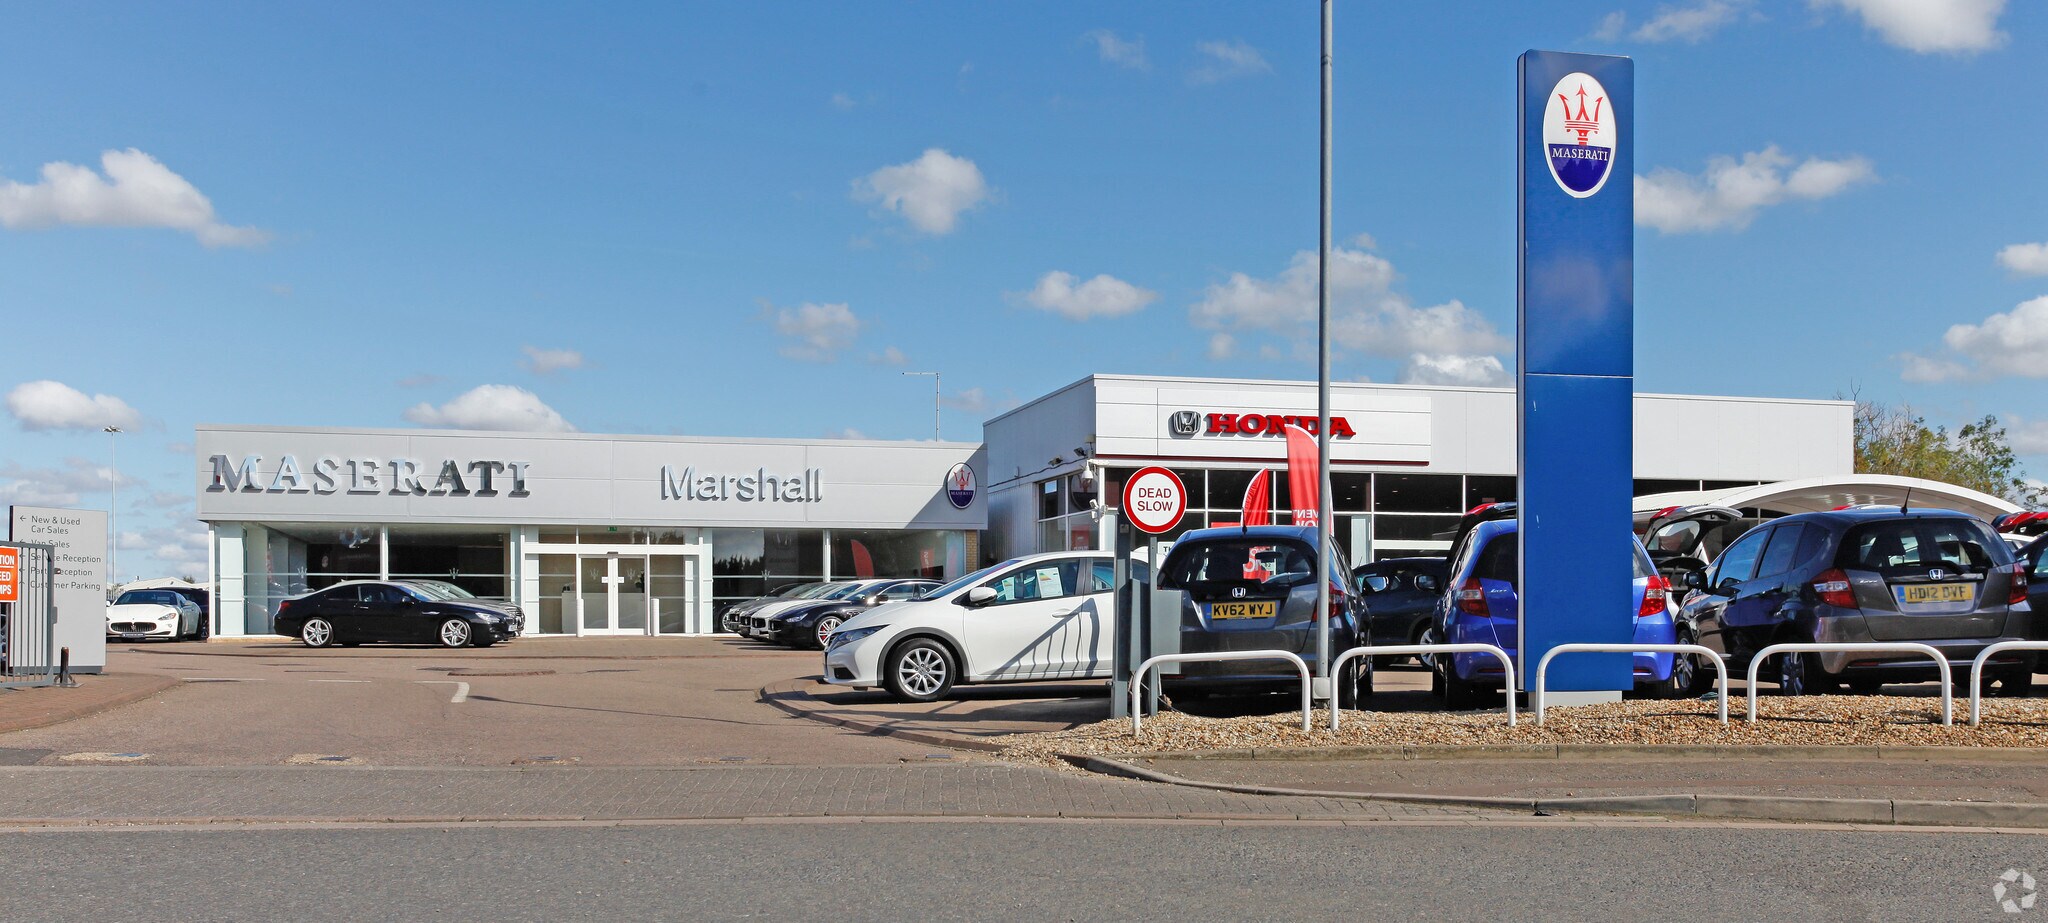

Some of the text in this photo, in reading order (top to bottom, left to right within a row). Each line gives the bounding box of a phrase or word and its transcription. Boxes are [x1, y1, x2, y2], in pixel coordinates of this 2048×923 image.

[1552, 148, 1608, 161] MASERATI
[1206, 413, 1356, 438] HONDA
[206, 454, 532, 498] MASERATI
[661, 465, 823, 502] Marshall
[1138, 487, 1172, 498] DEAD
[1137, 501, 1173, 511] SLOW
[31, 515, 80, 525] New & Used
[31, 525, 69, 534] Car Sales
[62, 554, 101, 563] Reception
[60, 569, 93, 577] eception
[71, 581, 101, 591] Parking
[1909, 587, 1966, 599] HD12 DVF
[1213, 604, 1273, 616] KV62 WYJ
